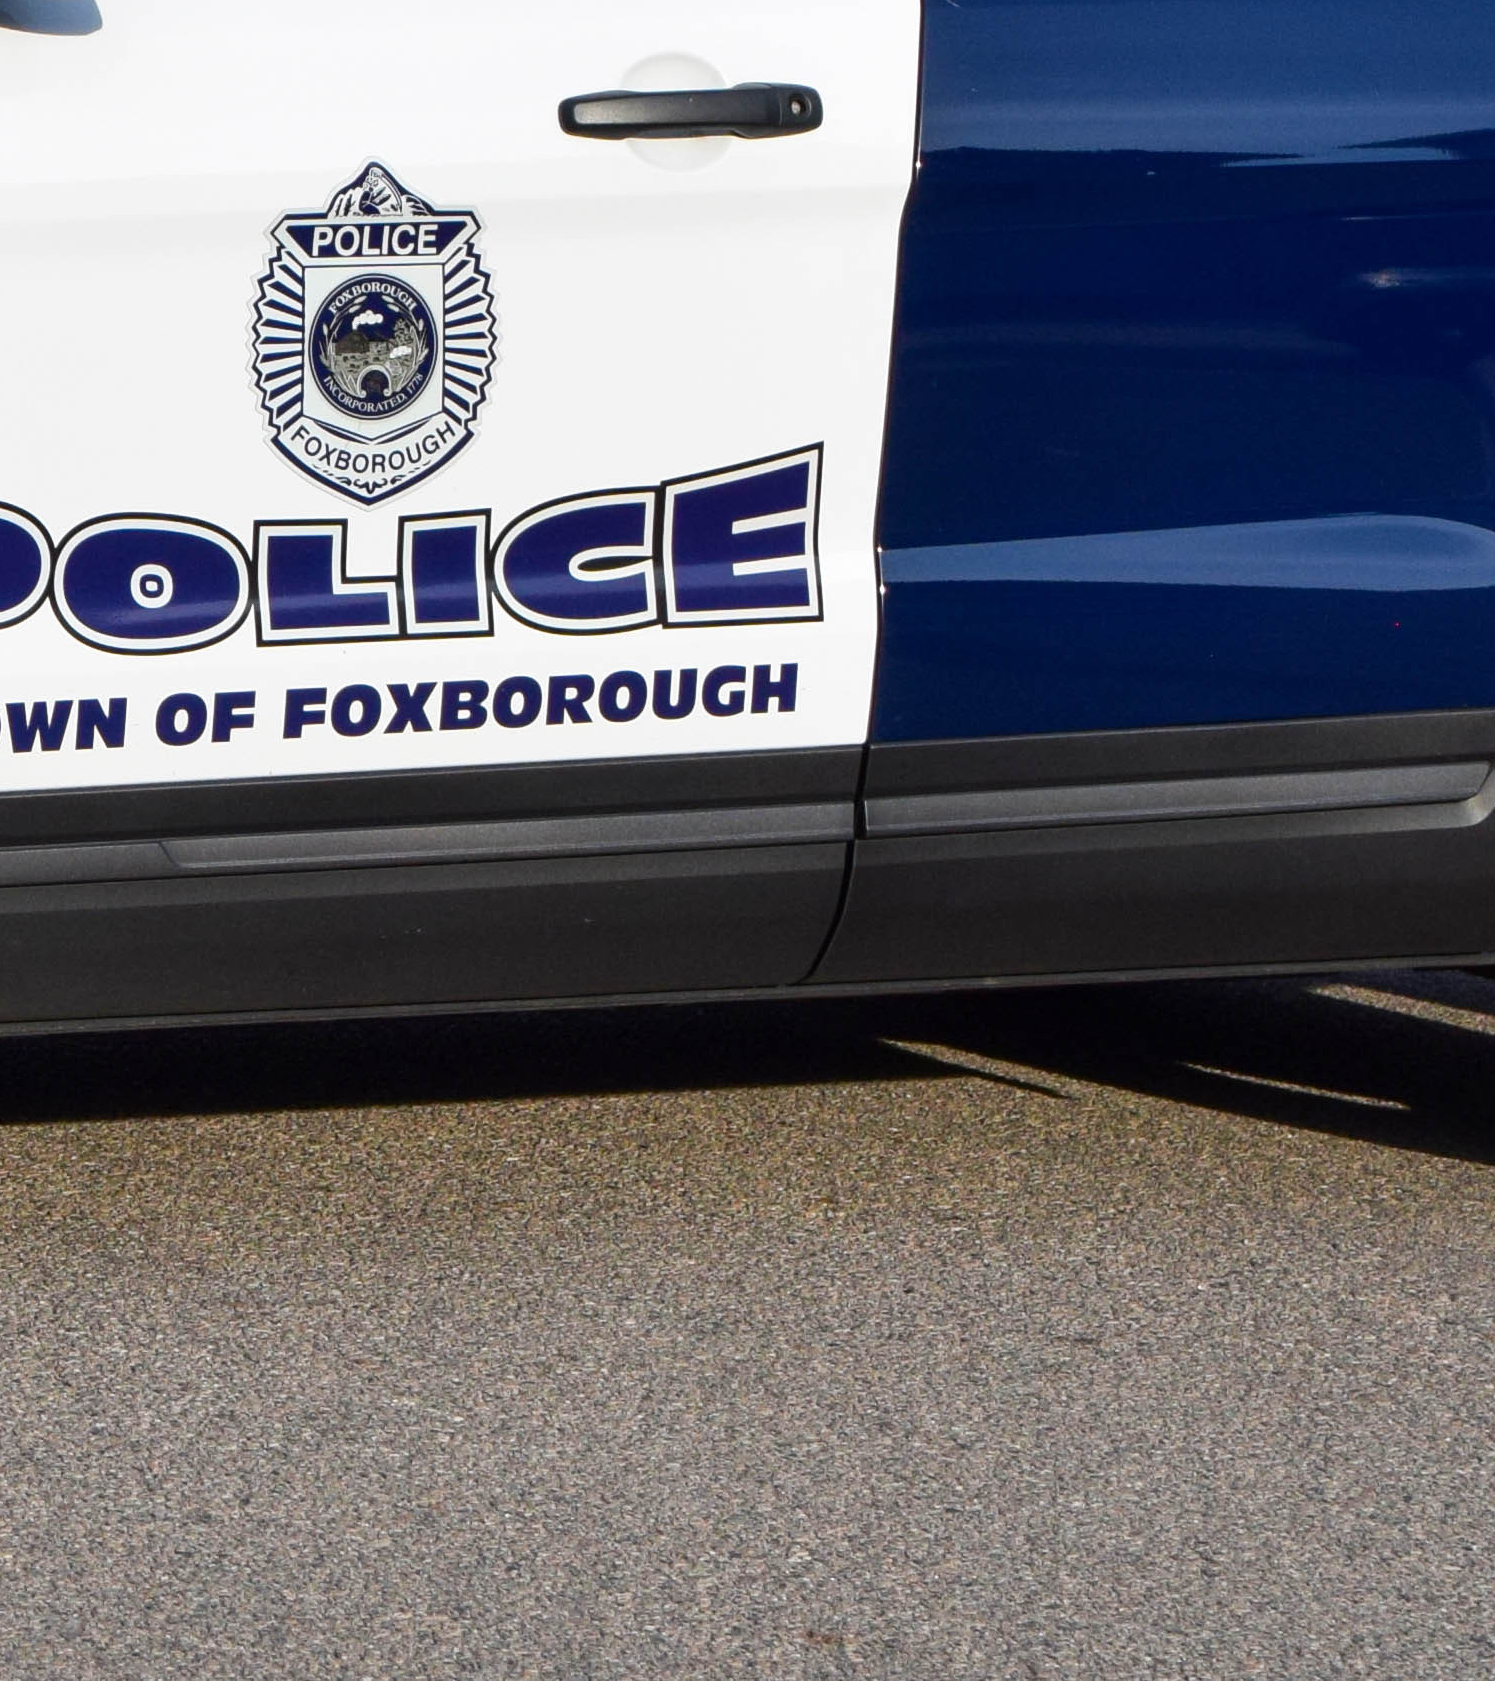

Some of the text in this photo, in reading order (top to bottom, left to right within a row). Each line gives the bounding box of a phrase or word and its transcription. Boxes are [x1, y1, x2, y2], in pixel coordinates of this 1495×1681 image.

[311, 223, 439, 257] POLICE
[329, 282, 417, 314] FOXBOROUGH
[408, 372, 424, 394] 1778
[290, 421, 456, 473] FOXBOROUGH
[154, 690, 255, 745] OF
[283, 663, 800, 740] FOXBOROUGH
